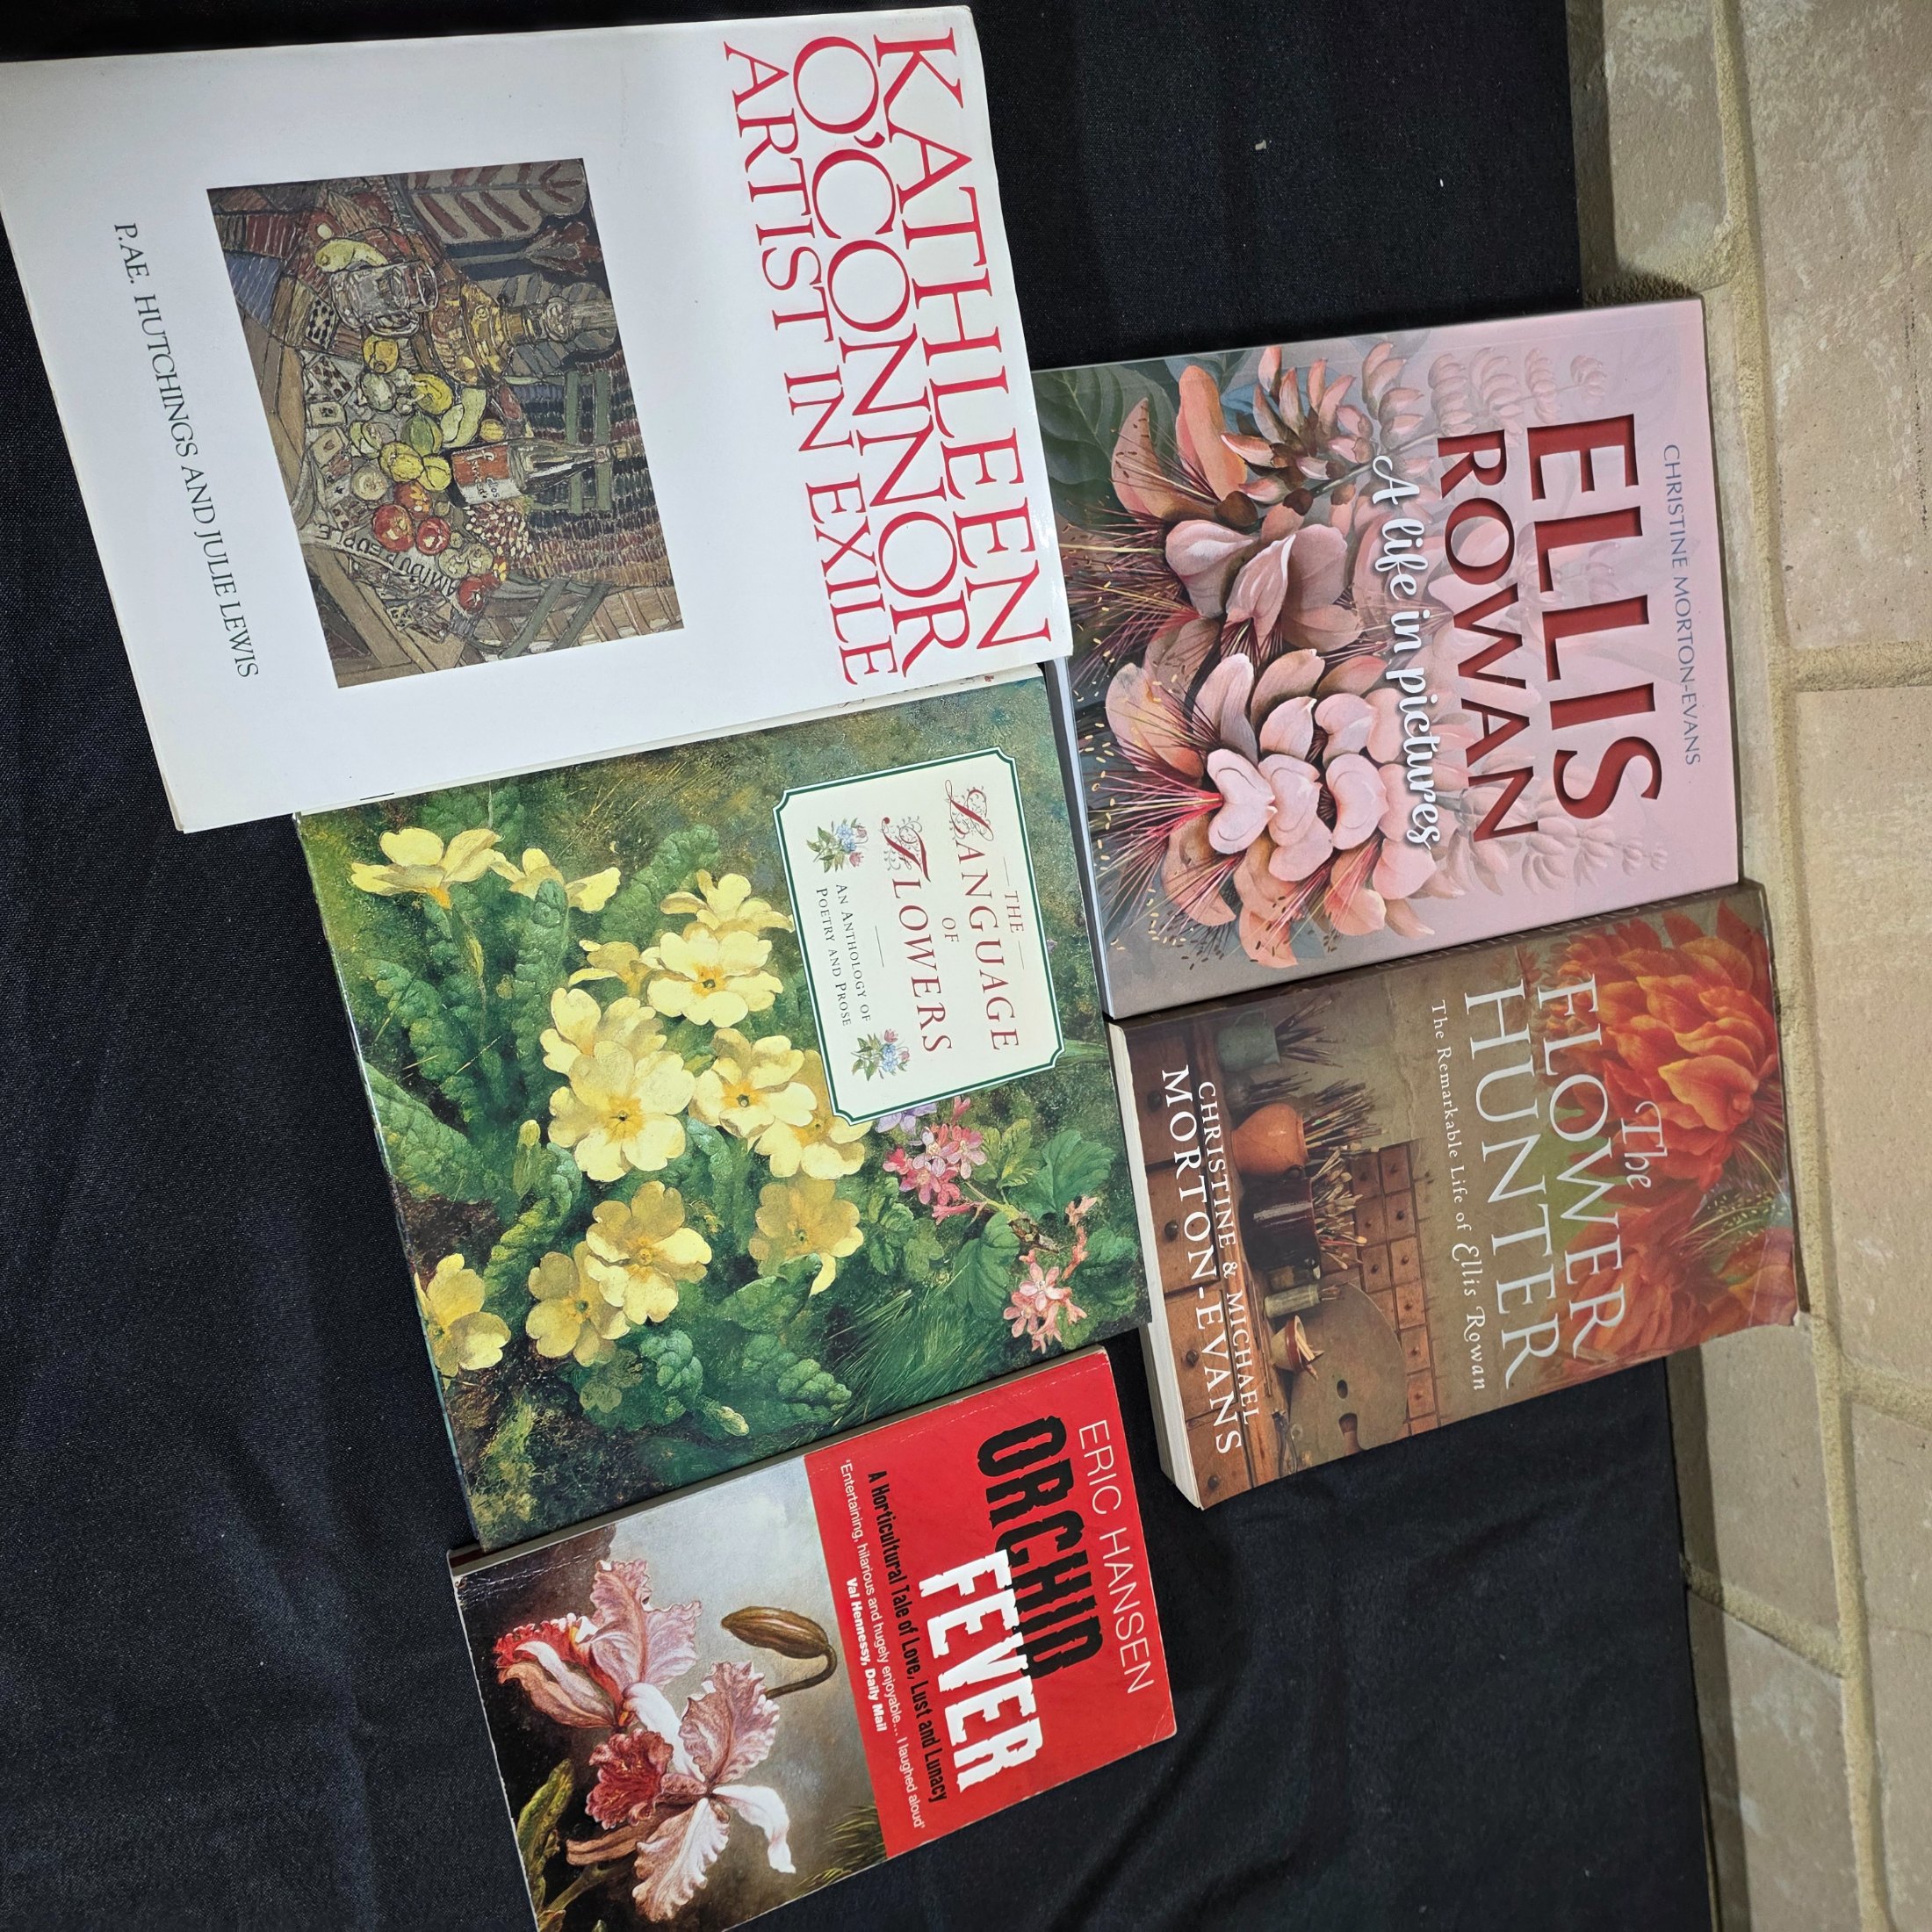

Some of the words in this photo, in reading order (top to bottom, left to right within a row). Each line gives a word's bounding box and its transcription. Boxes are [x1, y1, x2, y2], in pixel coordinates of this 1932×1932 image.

[723, 40, 834, 343] ARTIST
[133, 293, 198, 458] HUTCHINGS
[792, 35, 970, 678] O'CONNOR
[874, 26, 1051, 651] KATHLEEN
[783, 364, 855, 453] IN
[181, 464, 216, 525] AND
[1372, 455, 1420, 505] A
[1662, 443, 1689, 568] CHRISTINE
[193, 529, 237, 603] JULIE
[804, 472, 898, 686] EXILE
[1373, 518, 1429, 599] life
[220, 601, 259, 678] LEWIS
[1391, 609, 1431, 654] in
[1437, 429, 1539, 843] ROWAN
[1527, 413, 1662, 820] ELLIS
[1673, 575, 1701, 765] MORTON-EVANS
[1386, 667, 1442, 850] pictures
[836, 883, 848, 905] AN
[941, 917, 959, 943] OF
[945, 779, 1020, 1051] LANGUAGE
[1005, 890, 1025, 934] THE
[816, 888, 835, 941] POETRY
[828, 949, 841, 977] AND
[835, 983, 852, 1027] PROSE
[841, 912, 867, 998] ANTHOLOGY
[882, 816, 952, 1053] FLOWERS
[860, 1004, 871, 1022] OF
[1431, 999, 1448, 1040] The
[1437, 1047, 1462, 1158] Remarkable
[1198, 1081, 1237, 1250] CHRISTINE
[1451, 1165, 1467, 1204] Life
[1464, 978, 1561, 1388] HUNTER
[1538, 974, 1627, 1359] FLOWER
[1620, 1100, 1668, 1190] The
[1161, 1064, 1243, 1455] MORTON-EVANS
[1455, 1212, 1473, 1231] of
[1222, 1261, 1238, 1280] &
[1452, 1243, 1483, 1296] Ellis
[1226, 1292, 1261, 1425] MICHAEL
[1463, 1306, 1486, 1391] Rowan
[868, 1470, 887, 1483] A
[1079, 1419, 1122, 1516] ERIC
[857, 1542, 875, 1596] hilarious
[871, 1483, 908, 1585] Horticultural
[977, 1416, 1104, 1681] ORCHID
[846, 1577, 860, 1598] Val
[868, 1597, 882, 1622] and
[891, 1584, 913, 1618] Tale
[1099, 1527, 1155, 1695] HANSEN
[851, 1600, 871, 1666] Hennessy,
[873, 1622, 890, 1663] hugely
[898, 1620, 920, 1637] of
[901, 1636, 921, 1680] Love,
[864, 1668, 878, 1701] Daily
[911, 1680, 934, 1719] Lust
[919, 1549, 1044, 1793] FEVER
[872, 1703, 888, 1732] Mail
[918, 1719, 941, 1748] and
[898, 1742, 918, 1793] laughed
[924, 1748, 948, 1803] Lunacy
